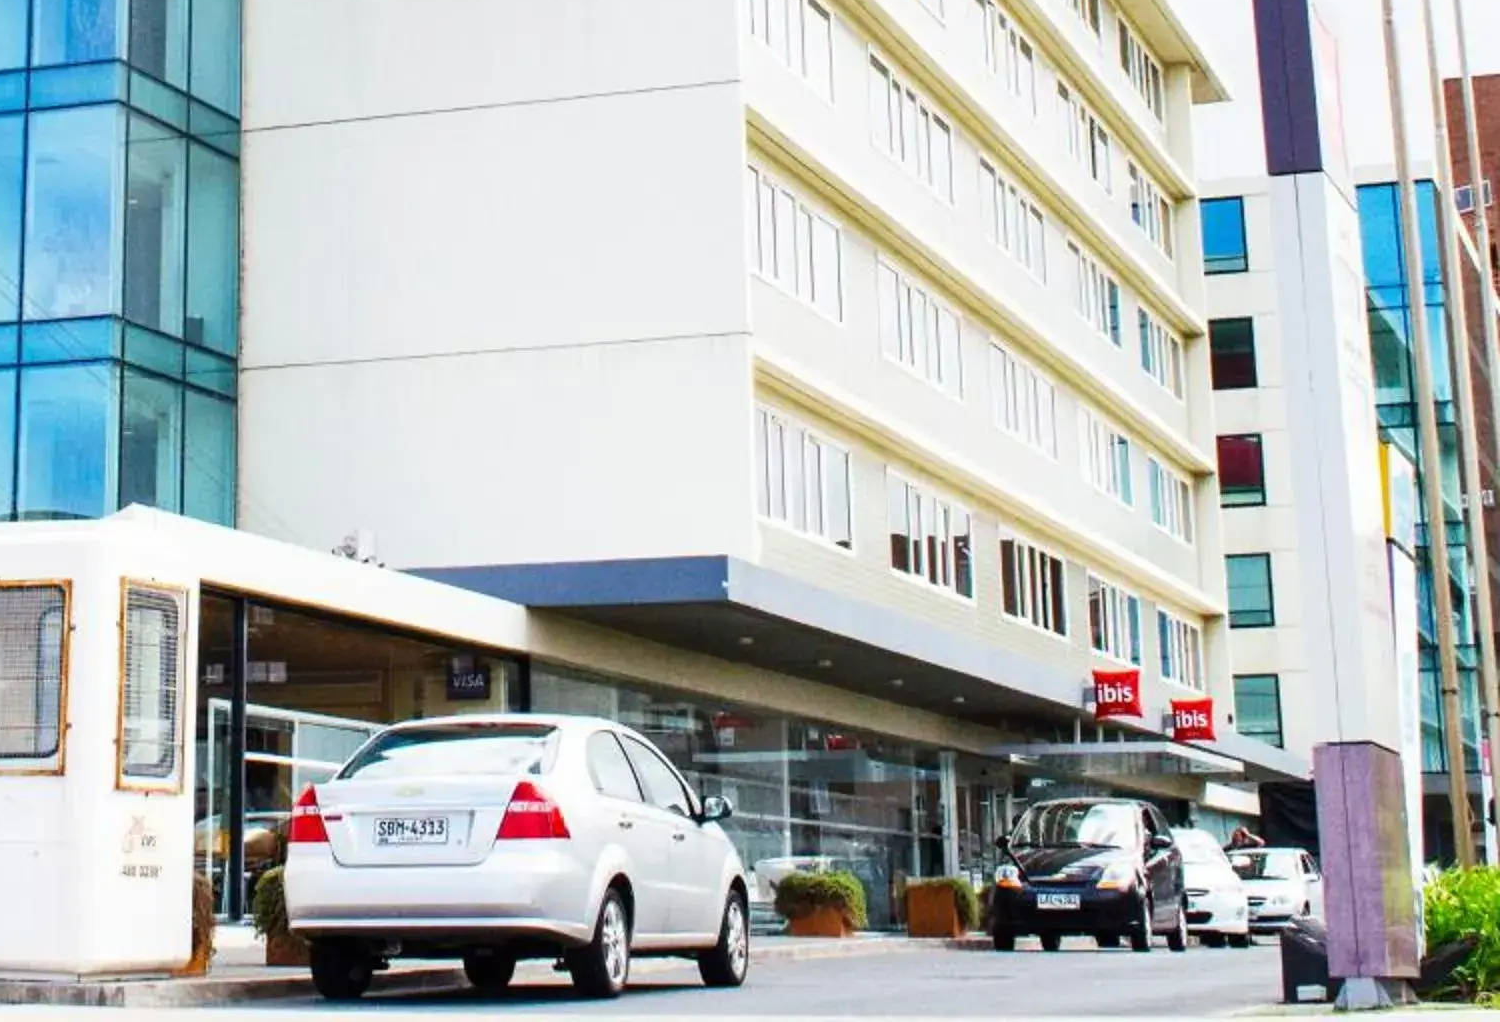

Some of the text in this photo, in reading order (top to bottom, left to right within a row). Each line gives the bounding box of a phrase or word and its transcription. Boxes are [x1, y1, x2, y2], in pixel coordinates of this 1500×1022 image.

[453, 673, 484, 688] VISA
[1097, 682, 1133, 703] ibis
[1175, 709, 1208, 728] ibis
